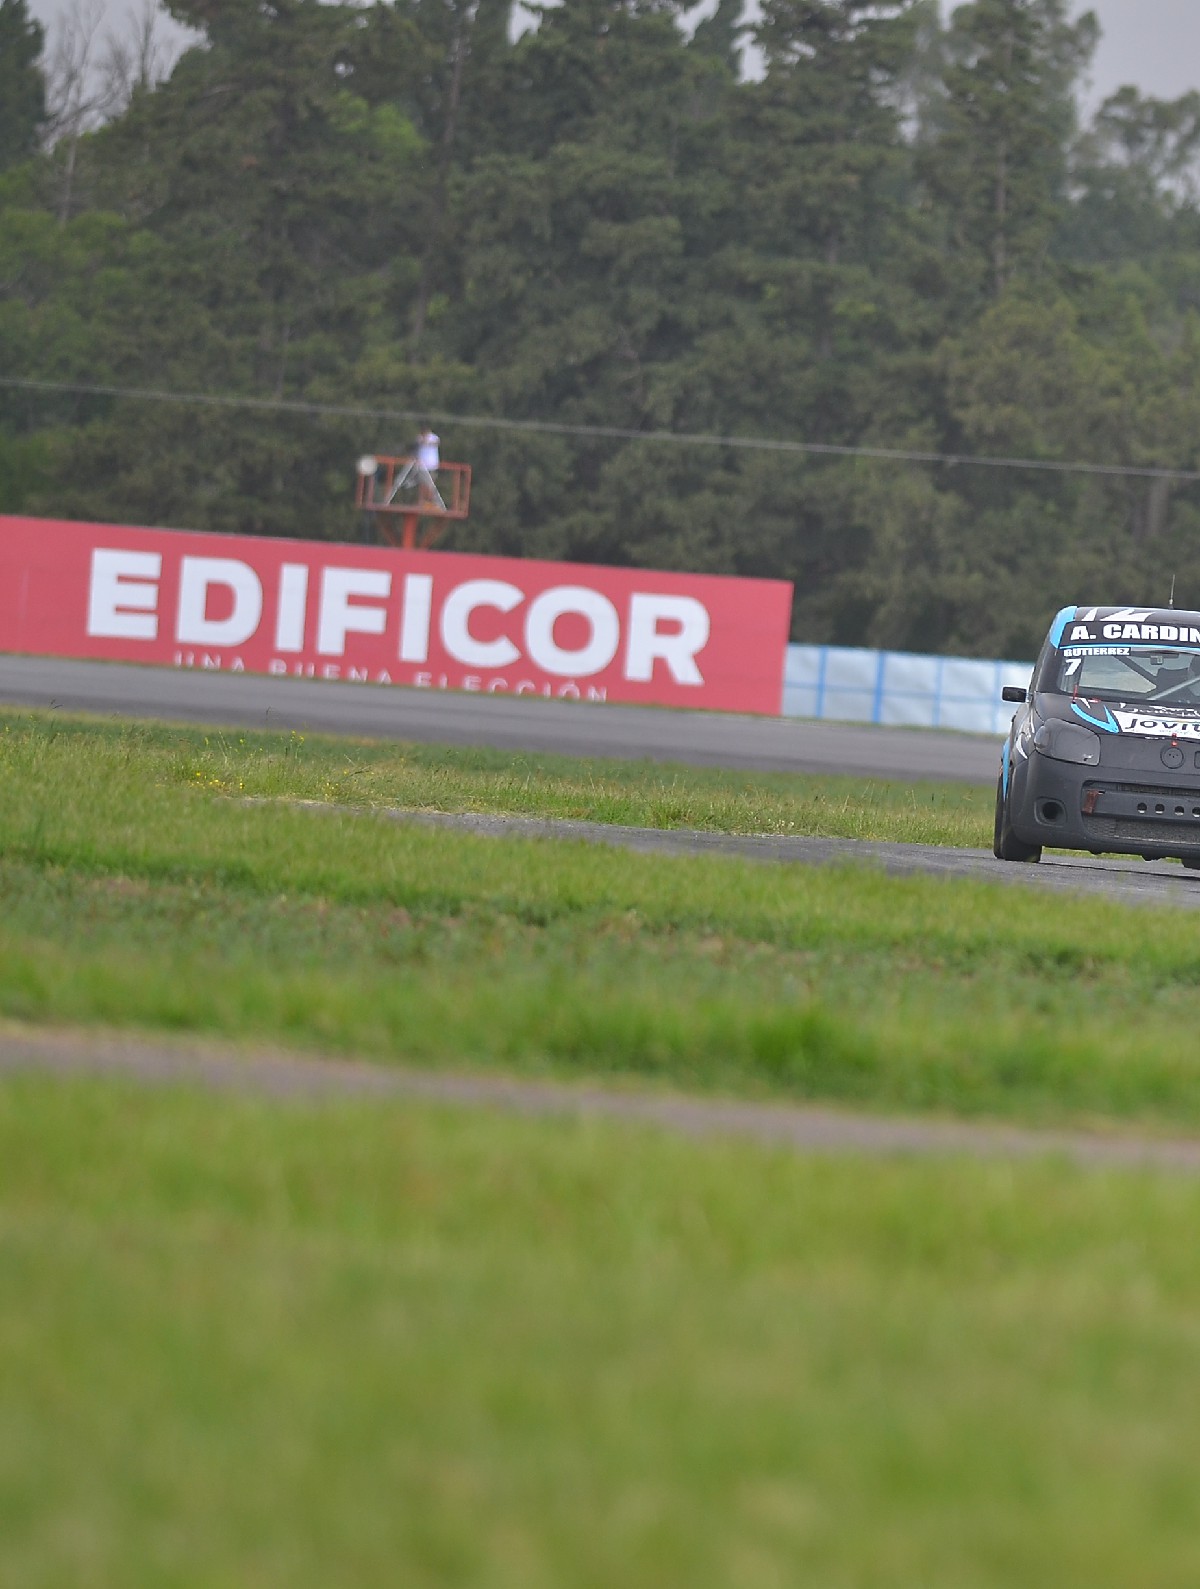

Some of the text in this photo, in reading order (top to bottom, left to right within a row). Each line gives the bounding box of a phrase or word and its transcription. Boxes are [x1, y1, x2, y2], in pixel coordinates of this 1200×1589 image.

[86, 547, 711, 686] EDIFICOR
[1070, 625, 1097, 641] A.
[1064, 658, 1082, 676] 7
